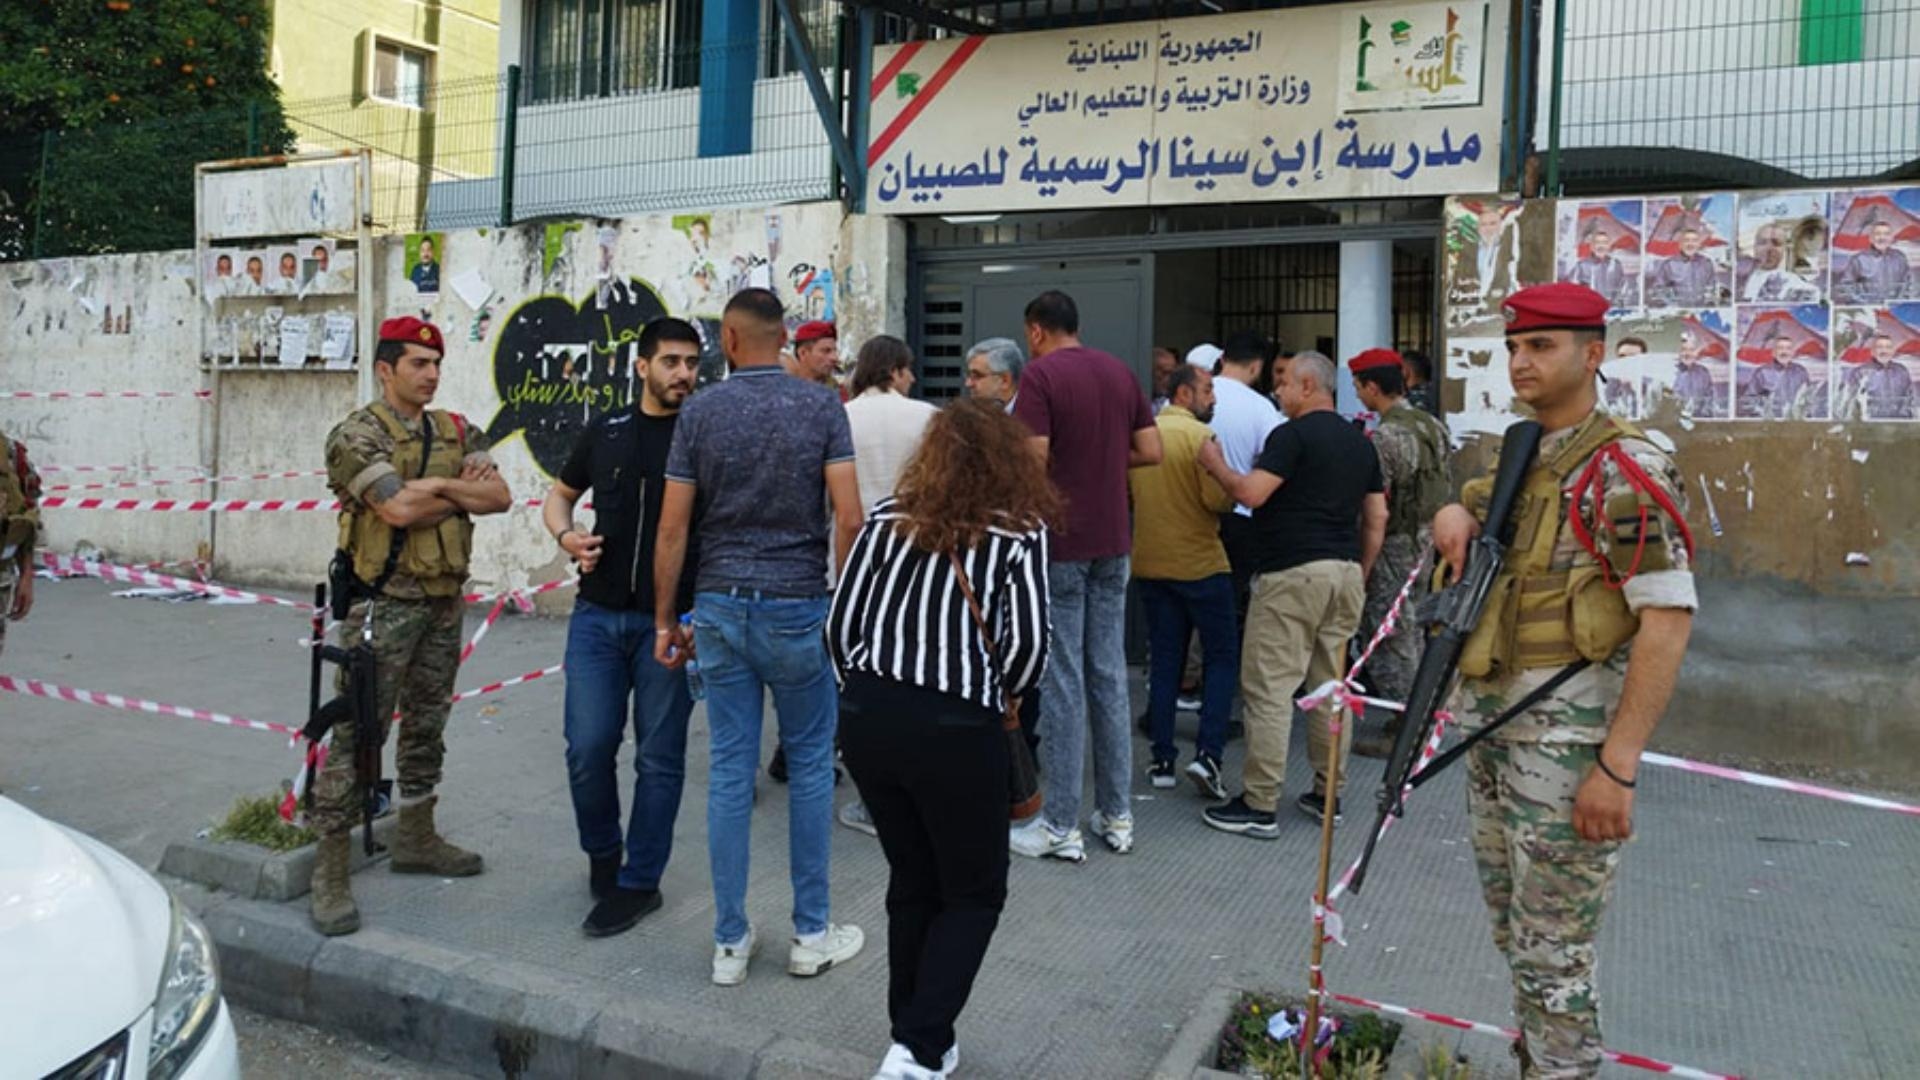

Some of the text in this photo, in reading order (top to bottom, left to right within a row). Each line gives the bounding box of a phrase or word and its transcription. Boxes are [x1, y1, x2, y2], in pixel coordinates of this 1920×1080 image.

[1067, 30, 1262, 72] الجمهورية اللبنانية
[1018, 88, 1078, 128] العالي
[1176, 76, 1251, 112] التربية
[1258, 74, 1311, 107] وزارة
[877, 117, 1482, 202] مدرسة إبن سينا الرسمية للصبيان
